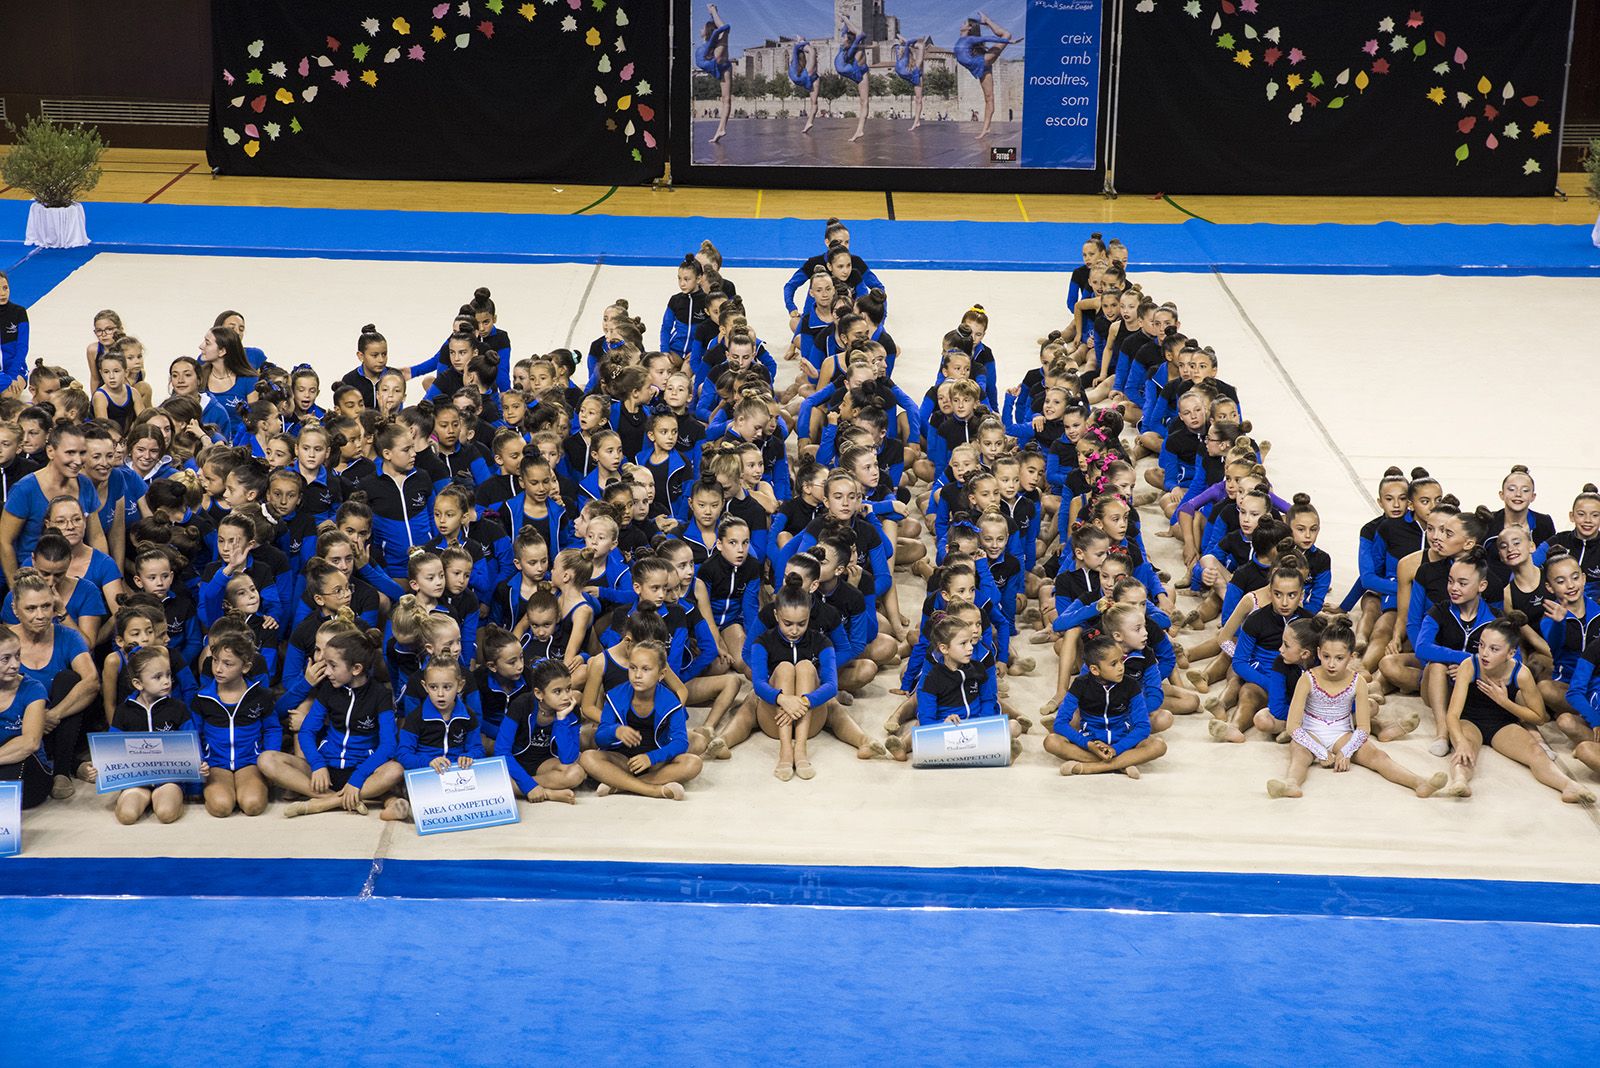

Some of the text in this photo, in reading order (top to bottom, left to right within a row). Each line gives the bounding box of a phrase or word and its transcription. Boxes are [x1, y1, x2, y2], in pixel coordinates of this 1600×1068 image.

[1060, 32, 1093, 45] creix
[1061, 51, 1091, 65] amb
[1029, 72, 1089, 88] nosaltres,
[1061, 96, 1089, 106] som
[1045, 113, 1089, 126] escola
[105, 760, 191, 772] ÀREA COMPETICIÓ
[106, 770, 150, 783] ESCOLAR
[150, 768, 185, 776] NIVELL
[423, 796, 505, 816] ÀREA COMPETICIÓ
[422, 815, 463, 827] ESCOLAR
